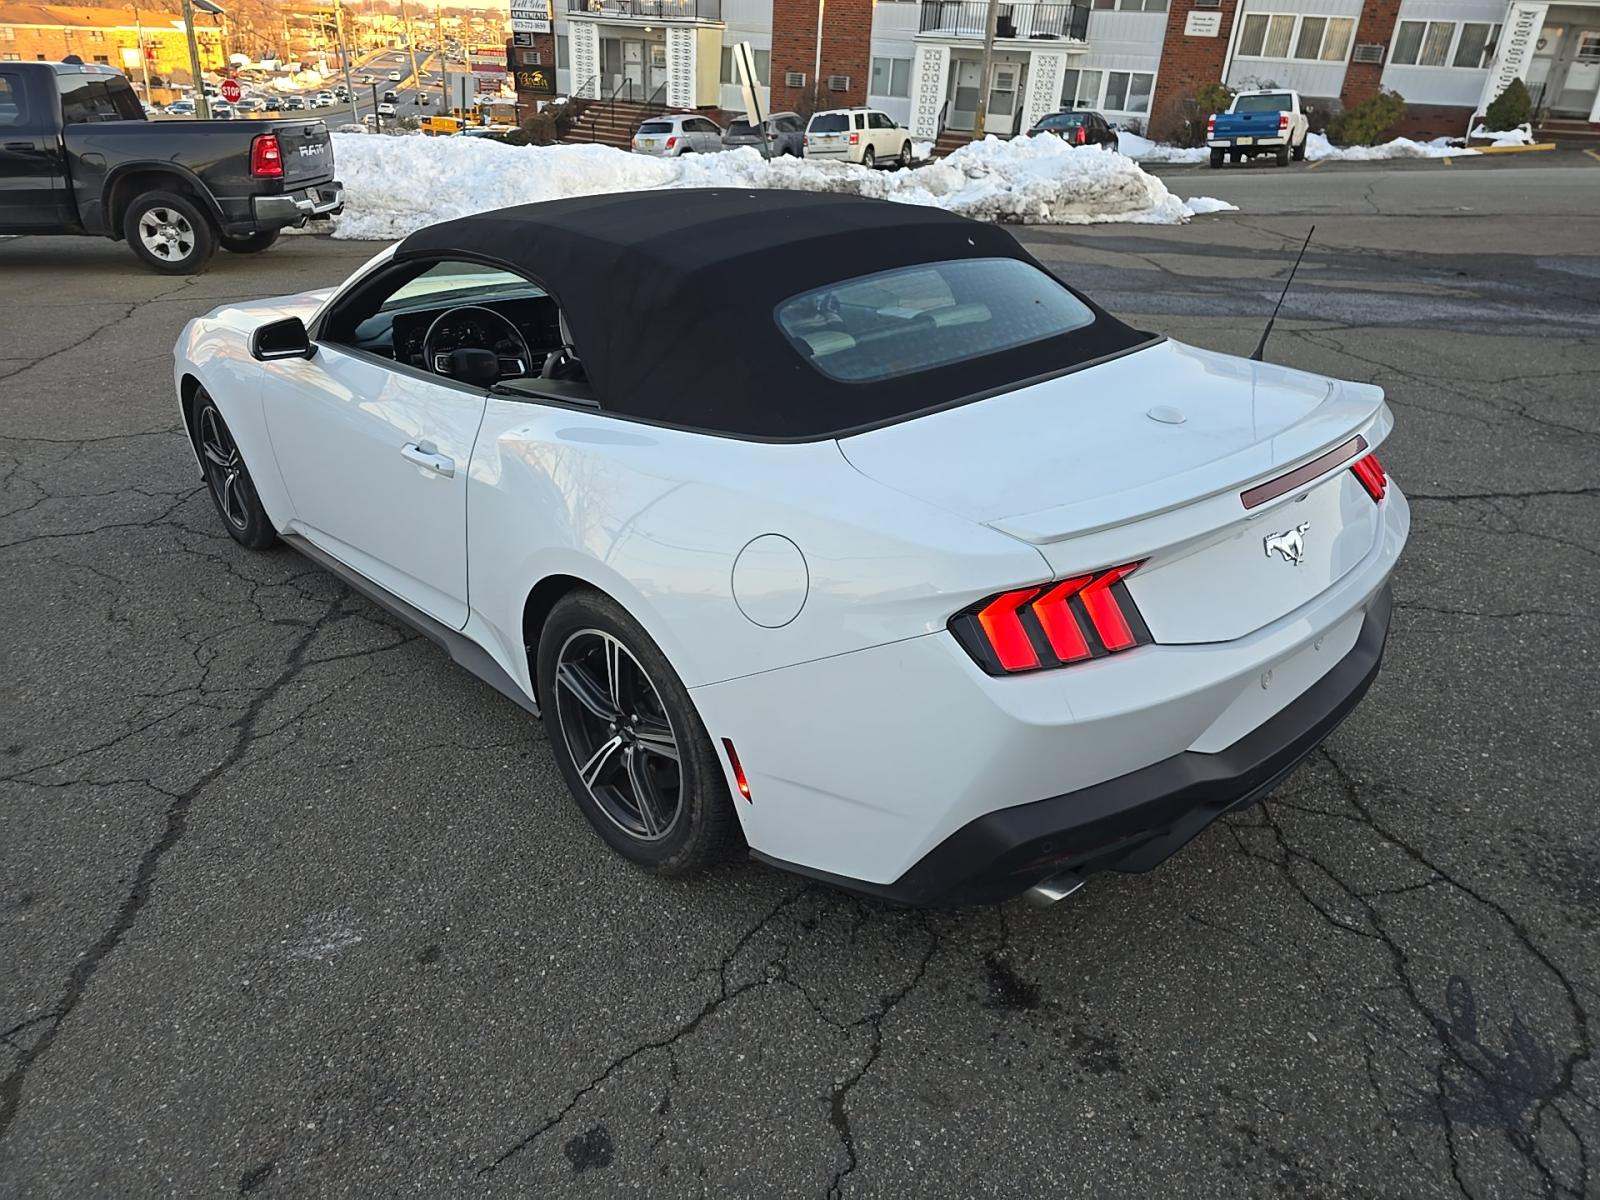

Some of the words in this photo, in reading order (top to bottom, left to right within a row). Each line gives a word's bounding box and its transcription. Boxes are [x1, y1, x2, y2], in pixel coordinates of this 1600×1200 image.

[512, 11, 547, 19] APARTMENTS
[222, 86, 239, 97] STOP
[299, 144, 325, 157] RAM
